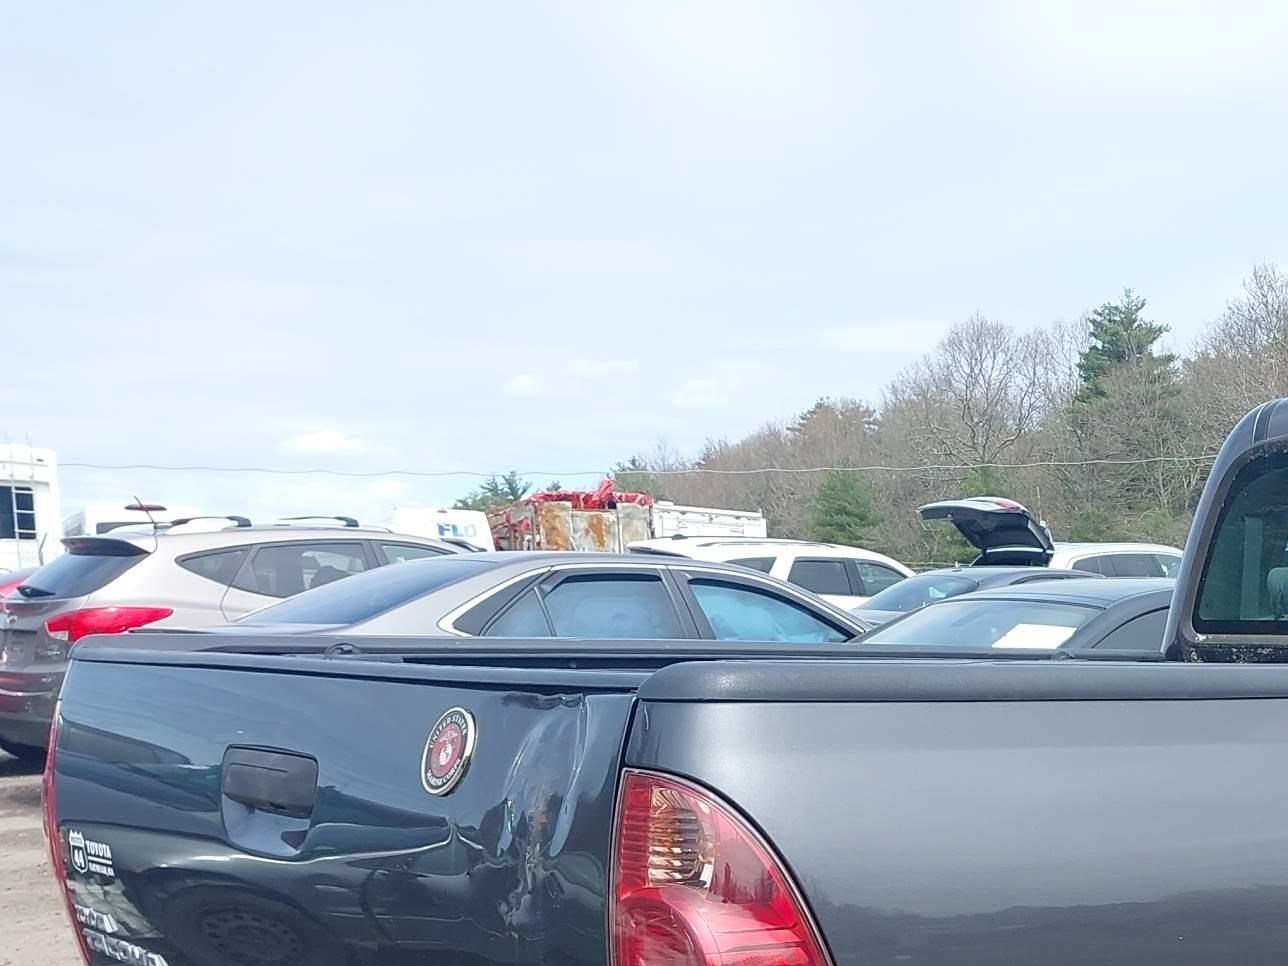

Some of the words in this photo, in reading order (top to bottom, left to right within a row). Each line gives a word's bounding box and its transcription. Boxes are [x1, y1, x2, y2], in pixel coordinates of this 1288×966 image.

[430, 716, 452, 748] UNITED
[452, 714, 468, 736] STATES
[443, 758, 461, 783] CORPS
[73, 848, 85, 869] 44
[85, 840, 112, 859] TOYOTA
